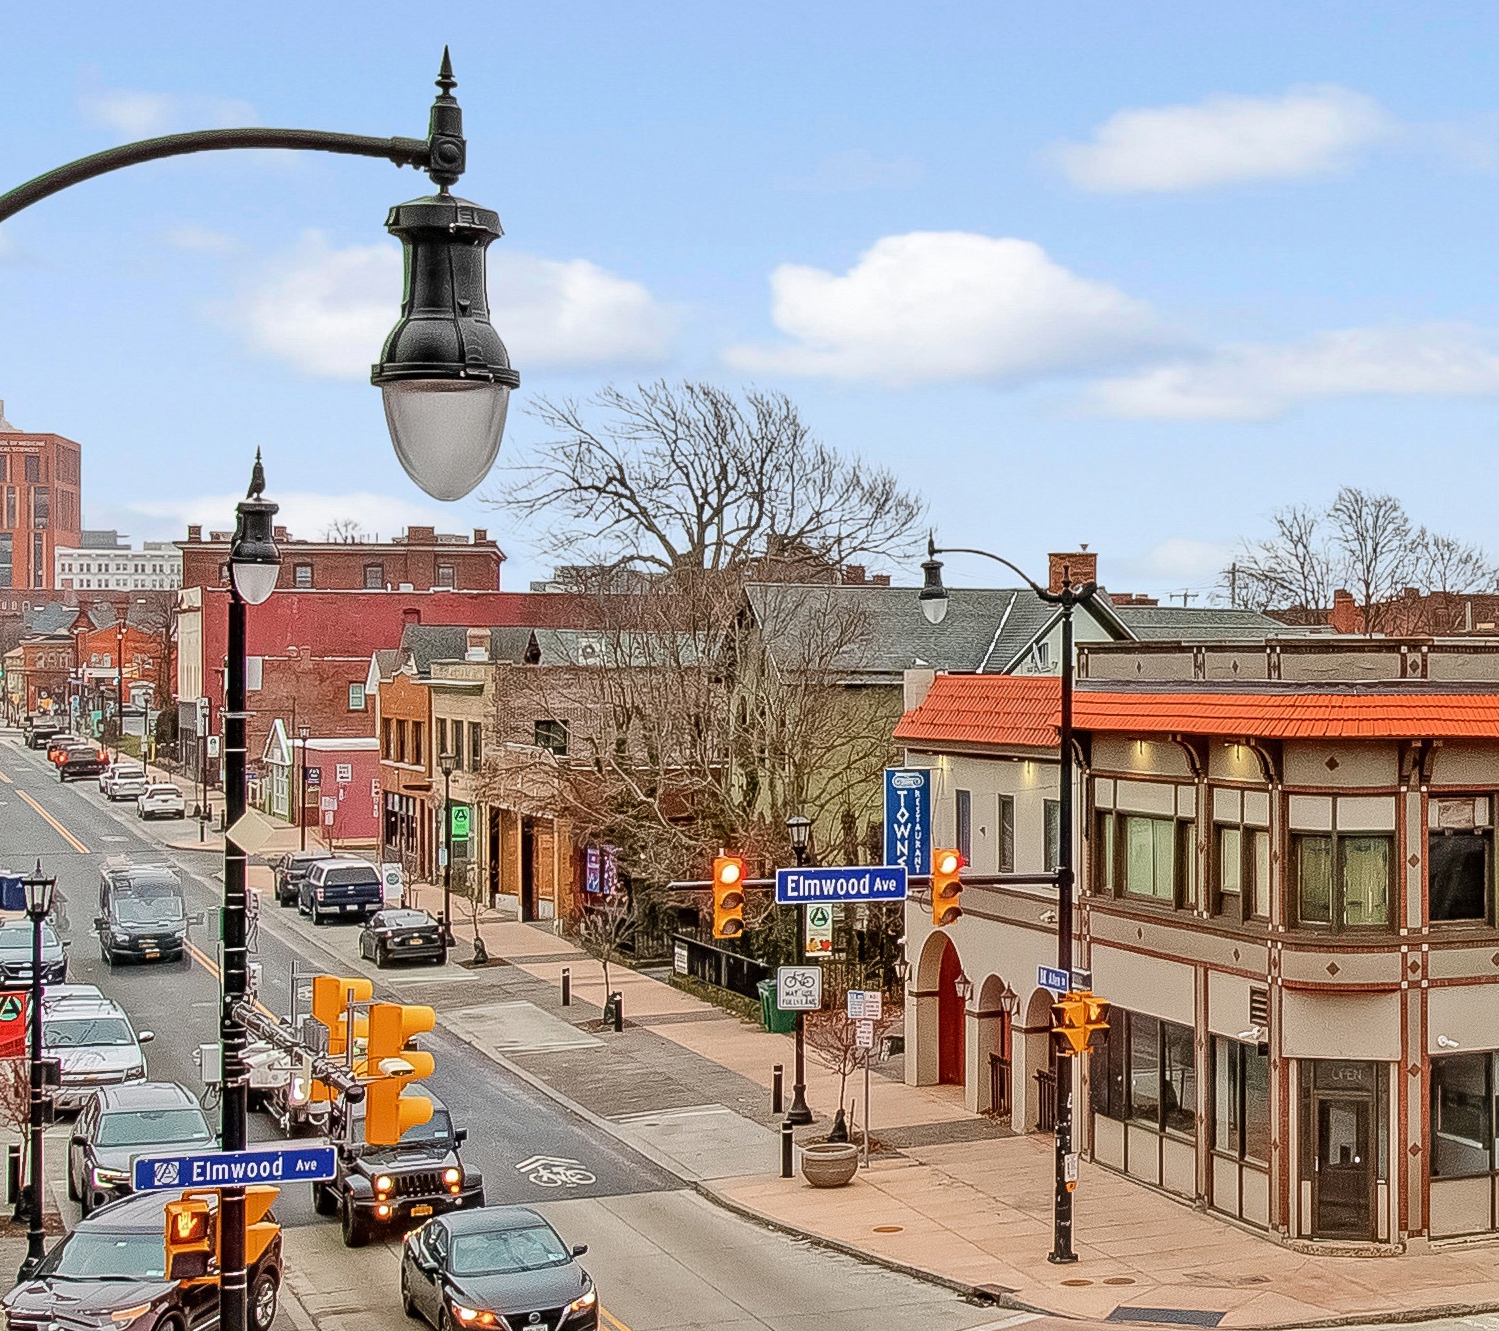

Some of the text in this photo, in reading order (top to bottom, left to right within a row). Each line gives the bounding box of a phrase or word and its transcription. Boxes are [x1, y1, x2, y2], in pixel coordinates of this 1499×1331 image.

[914, 789, 922, 874] RESTAURANT
[787, 873, 897, 897] Elmwood Ave
[193, 1156, 283, 1182] Elmwood
[295, 1159, 318, 1173] Ave
